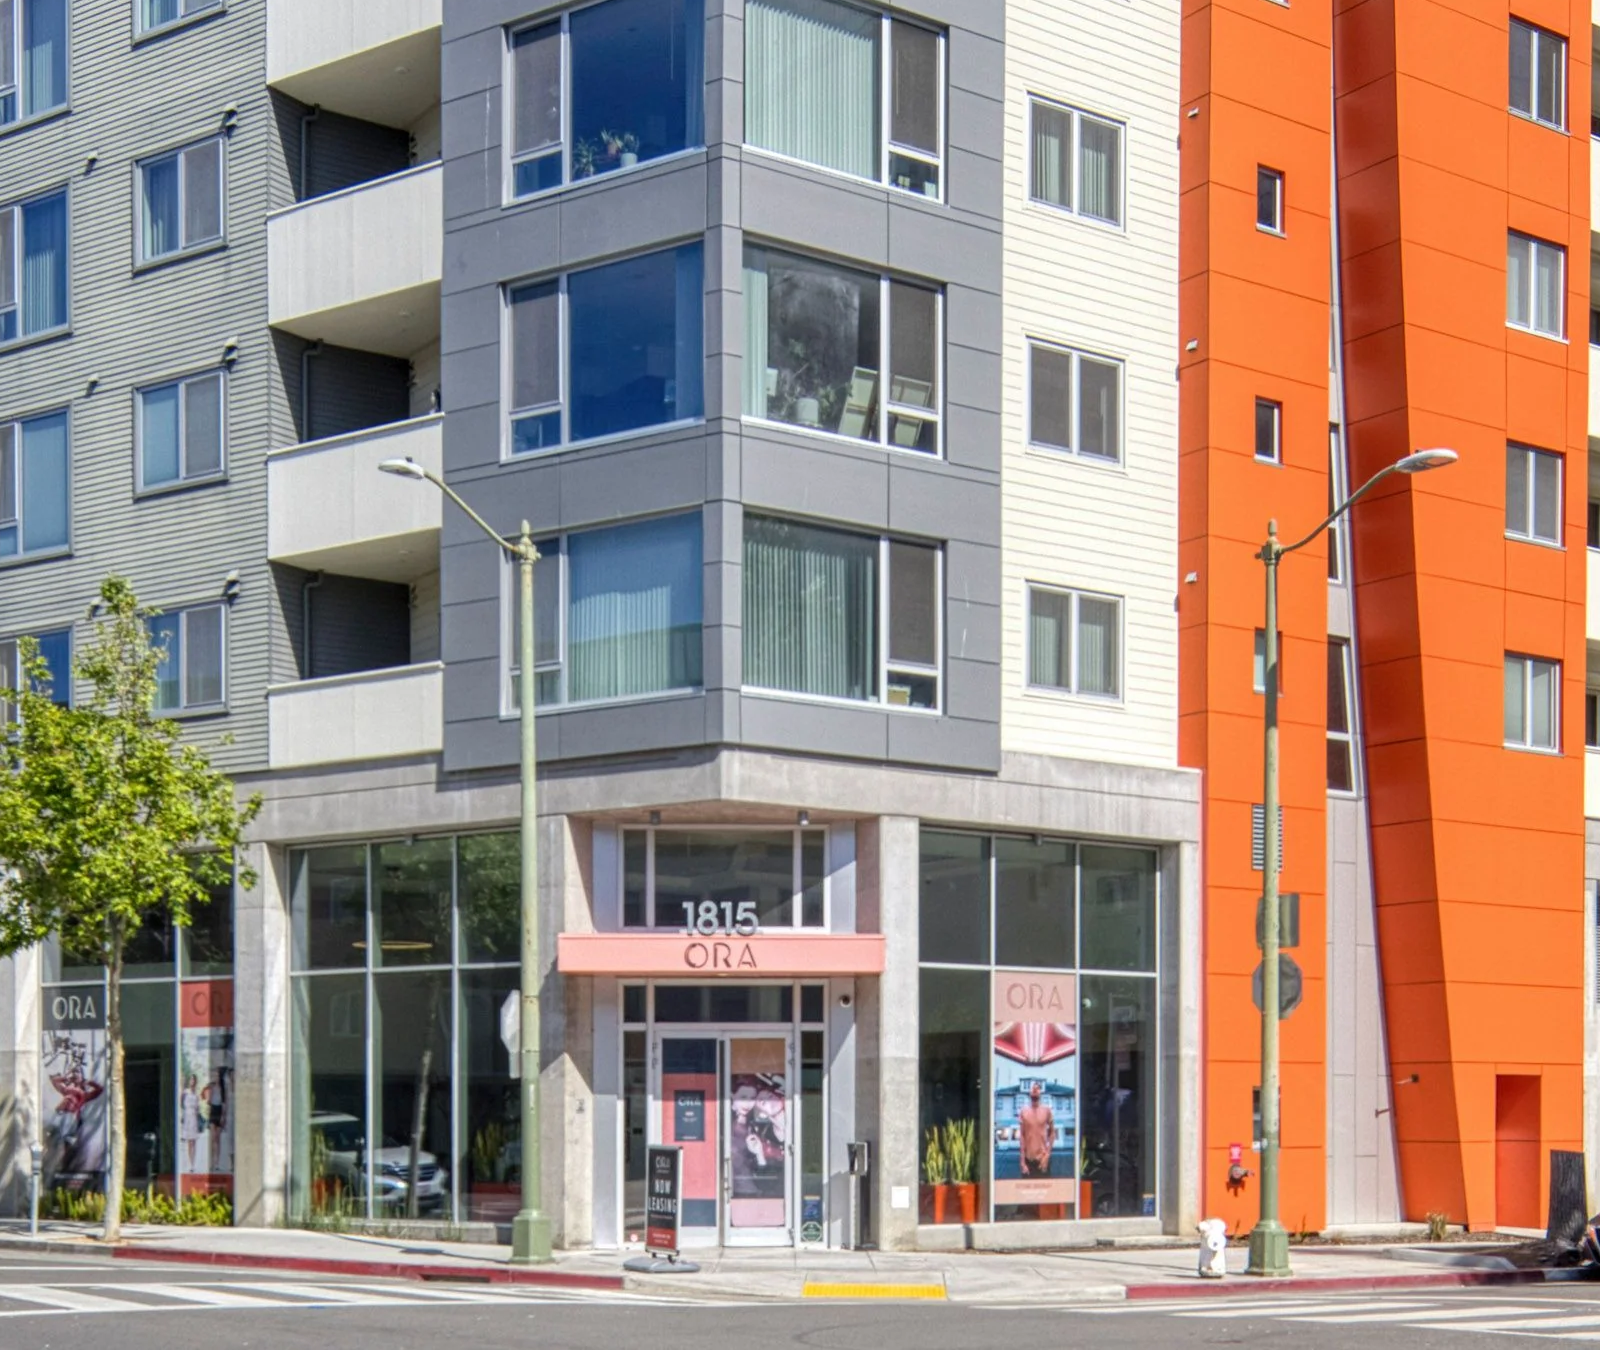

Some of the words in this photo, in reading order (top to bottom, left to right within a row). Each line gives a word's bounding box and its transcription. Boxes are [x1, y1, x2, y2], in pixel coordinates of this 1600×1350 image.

[682, 900, 759, 937] 1815
[684, 942, 757, 969] ORA
[52, 995, 97, 1020] ORA
[191, 990, 232, 1017] OR
[1006, 982, 1064, 1010] ORA
[654, 1178, 672, 1195] NOW
[647, 1196, 678, 1214] LEASING
